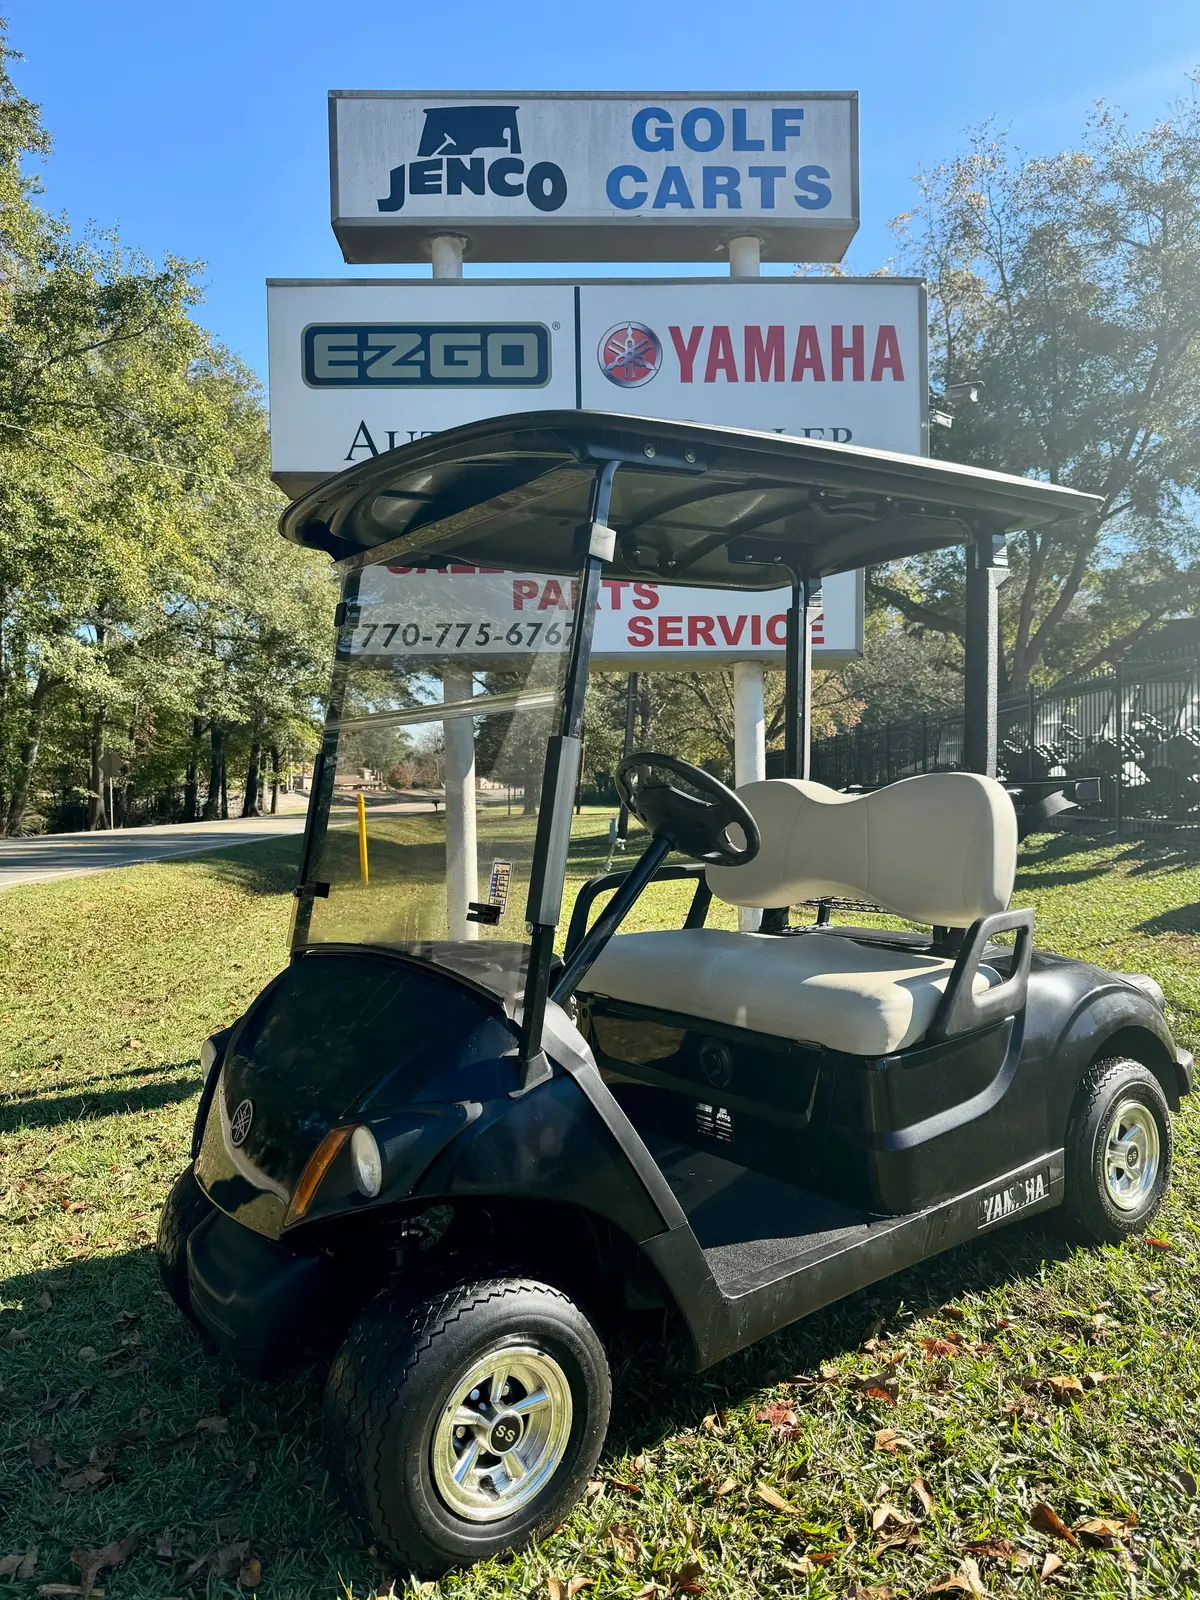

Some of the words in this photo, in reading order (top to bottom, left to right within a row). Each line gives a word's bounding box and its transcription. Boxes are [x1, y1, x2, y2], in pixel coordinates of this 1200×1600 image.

[631, 106, 805, 152] GOLF
[377, 157, 568, 213] JENCO
[605, 164, 833, 211] CARTS
[313, 333, 539, 379] EZGO
[668, 325, 906, 384] YAMAHA
[1128, 1151, 1137, 1162] SS
[495, 1425, 516, 1443] SS
